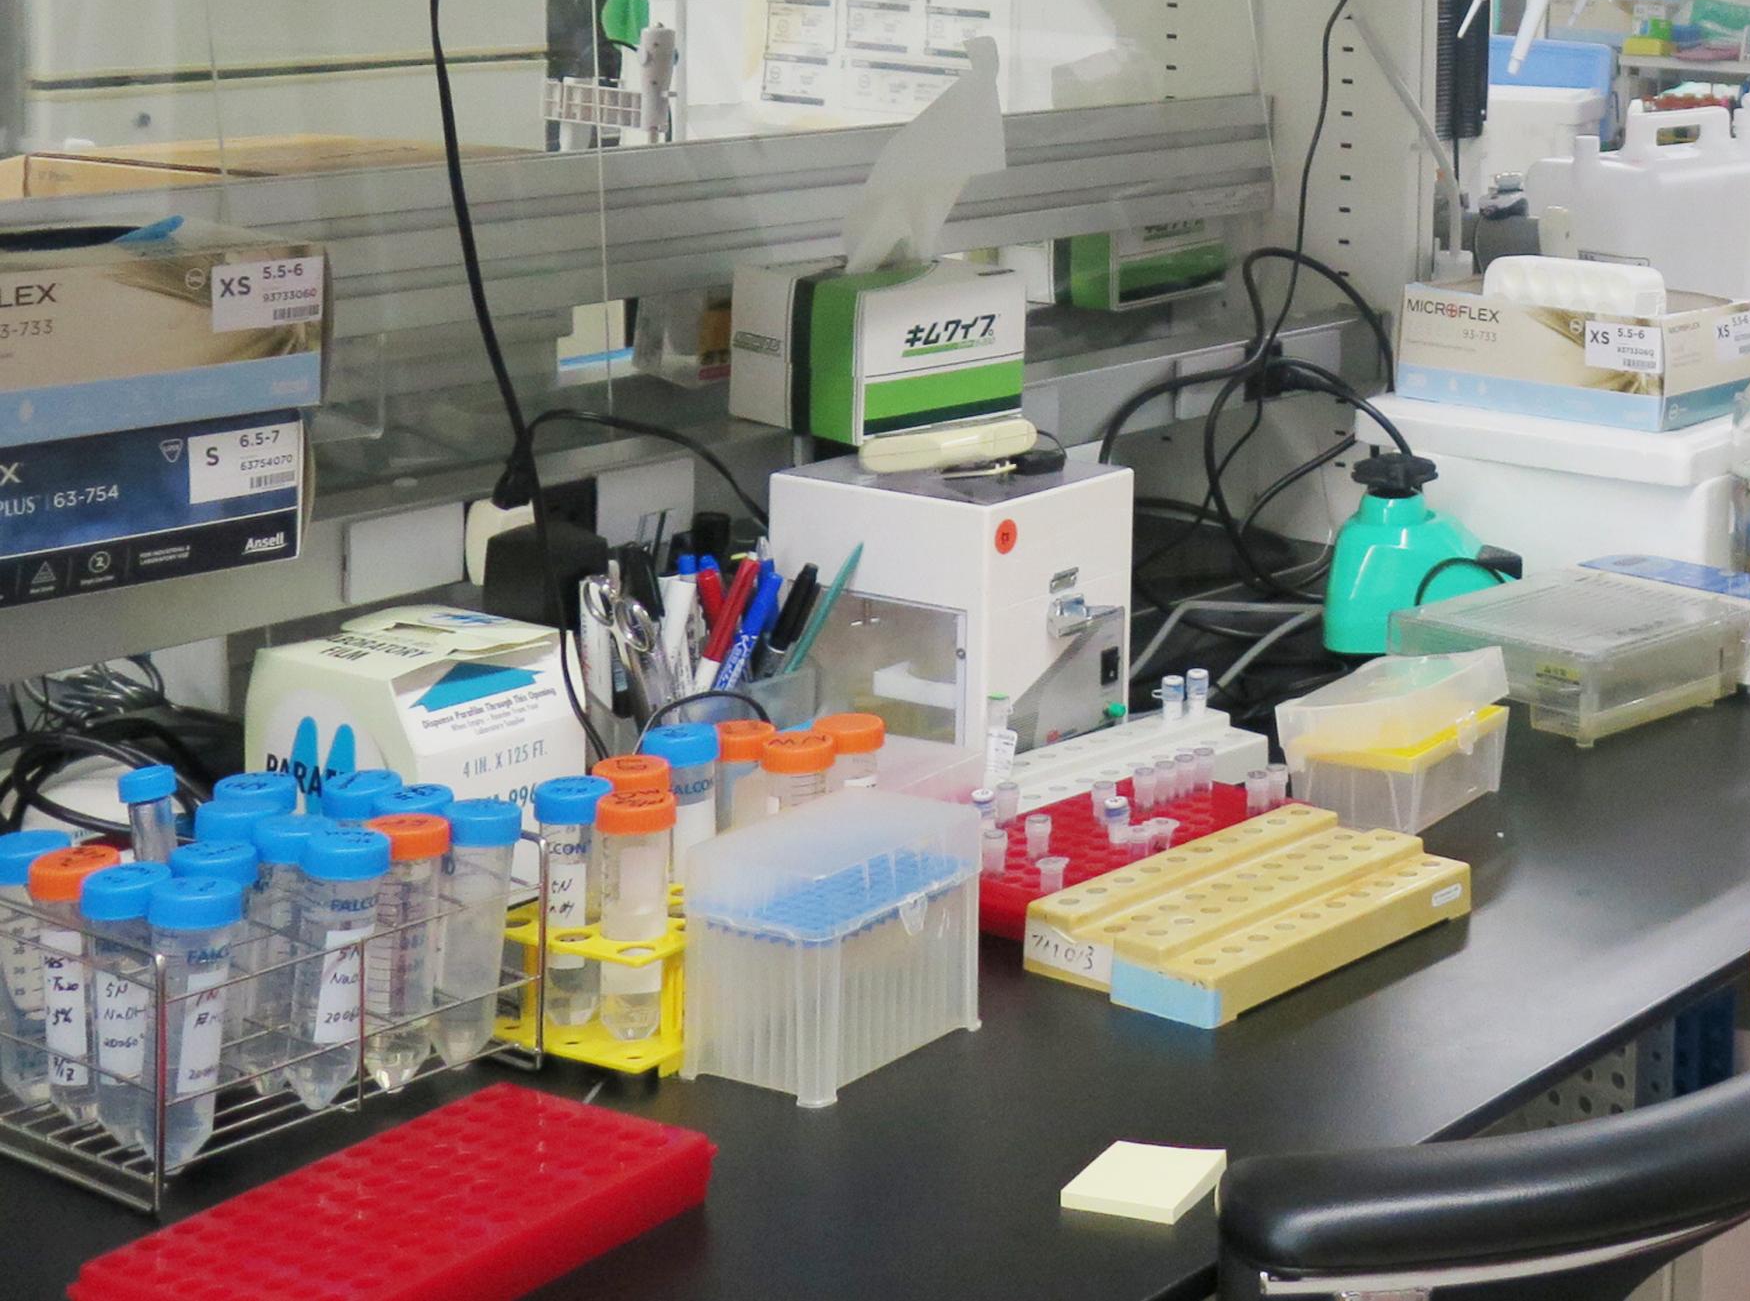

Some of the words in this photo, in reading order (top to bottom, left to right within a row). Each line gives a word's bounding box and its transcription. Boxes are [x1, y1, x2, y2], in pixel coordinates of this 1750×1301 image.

[220, 276, 251, 298] XS
[262, 262, 304, 281] 5.5-6
[262, 287, 318, 302] 93733060
[1406, 297, 1500, 325] MICROFLEX
[904, 313, 997, 348] キムワイプ
[1463, 328, 1498, 343] 93-733
[1590, 328, 1610, 346] XS
[1617, 326, 1645, 340] 5.5-6
[1717, 324, 1730, 340] XS
[240, 429, 280, 448] 6.5-7
[205, 446, 220, 467] S
[240, 453, 293, 471] 63754070
[53, 484, 119, 508] 63-754
[246, 531, 287, 552] Ansell
[463, 761, 470, 778] 4
[472, 756, 492, 774] IN.
[495, 752, 503, 770] X
[507, 745, 528, 765] 125
[531, 739, 548, 758] FT.
[669, 779, 714, 795] ALCO
[106, 981, 129, 998] 5N
